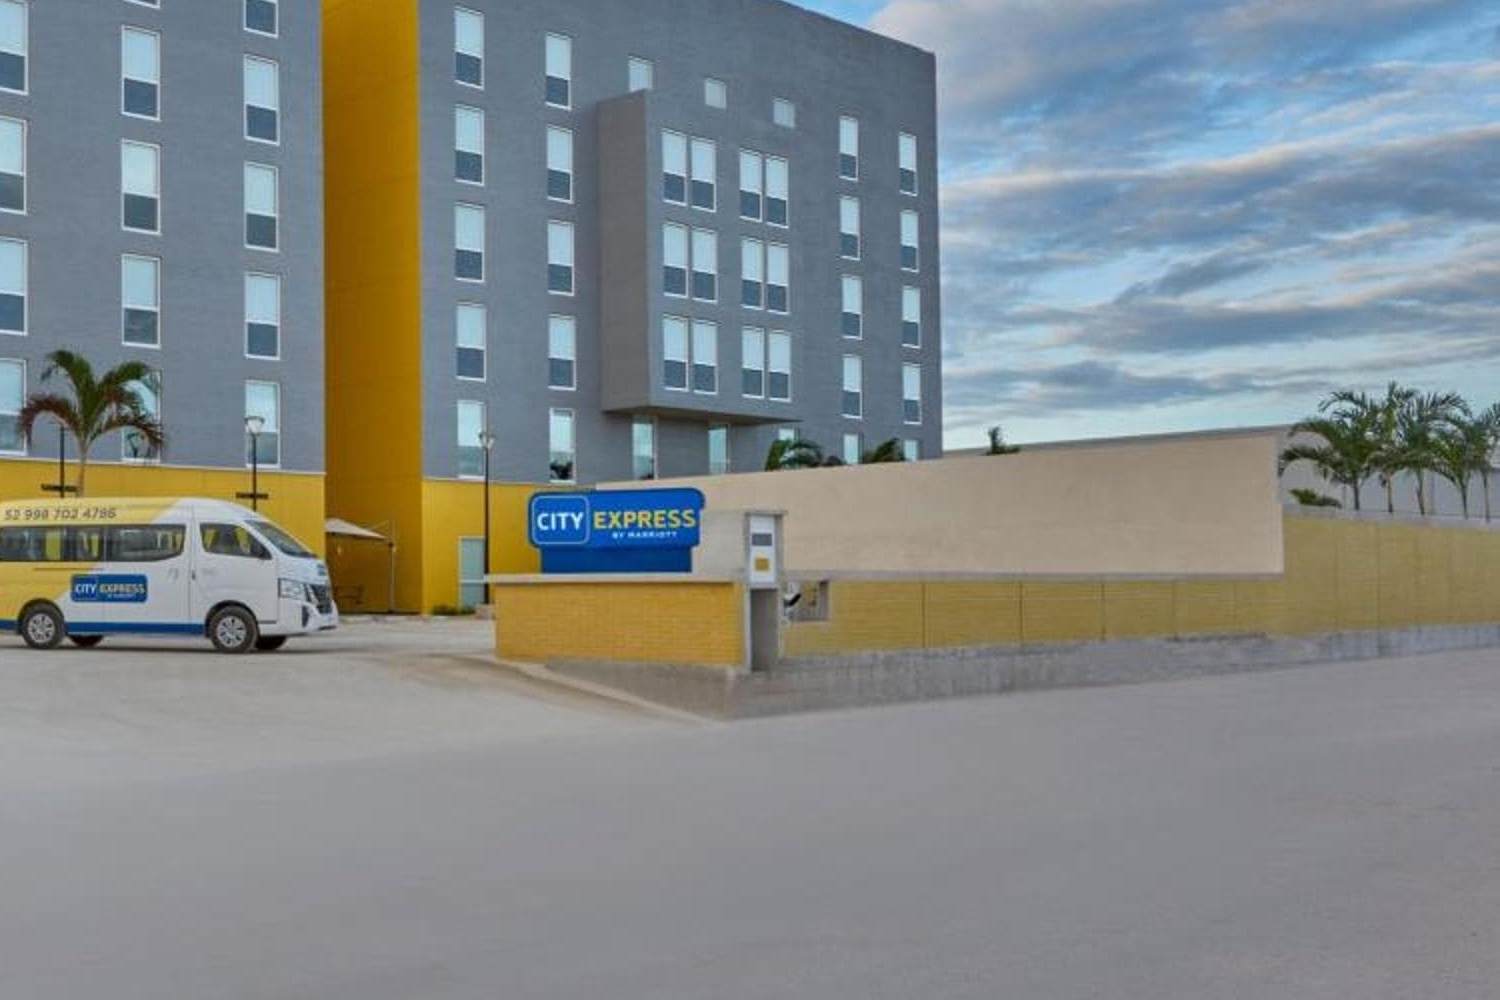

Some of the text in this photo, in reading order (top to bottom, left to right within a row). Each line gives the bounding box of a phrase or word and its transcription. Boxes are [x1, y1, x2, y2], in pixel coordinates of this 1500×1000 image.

[4, 508, 20, 520] 52
[537, 509, 697, 531] CITY EXPRESS
[627, 531, 678, 539] MARRIOTT
[75, 583, 146, 594] CITY EXPRESS
